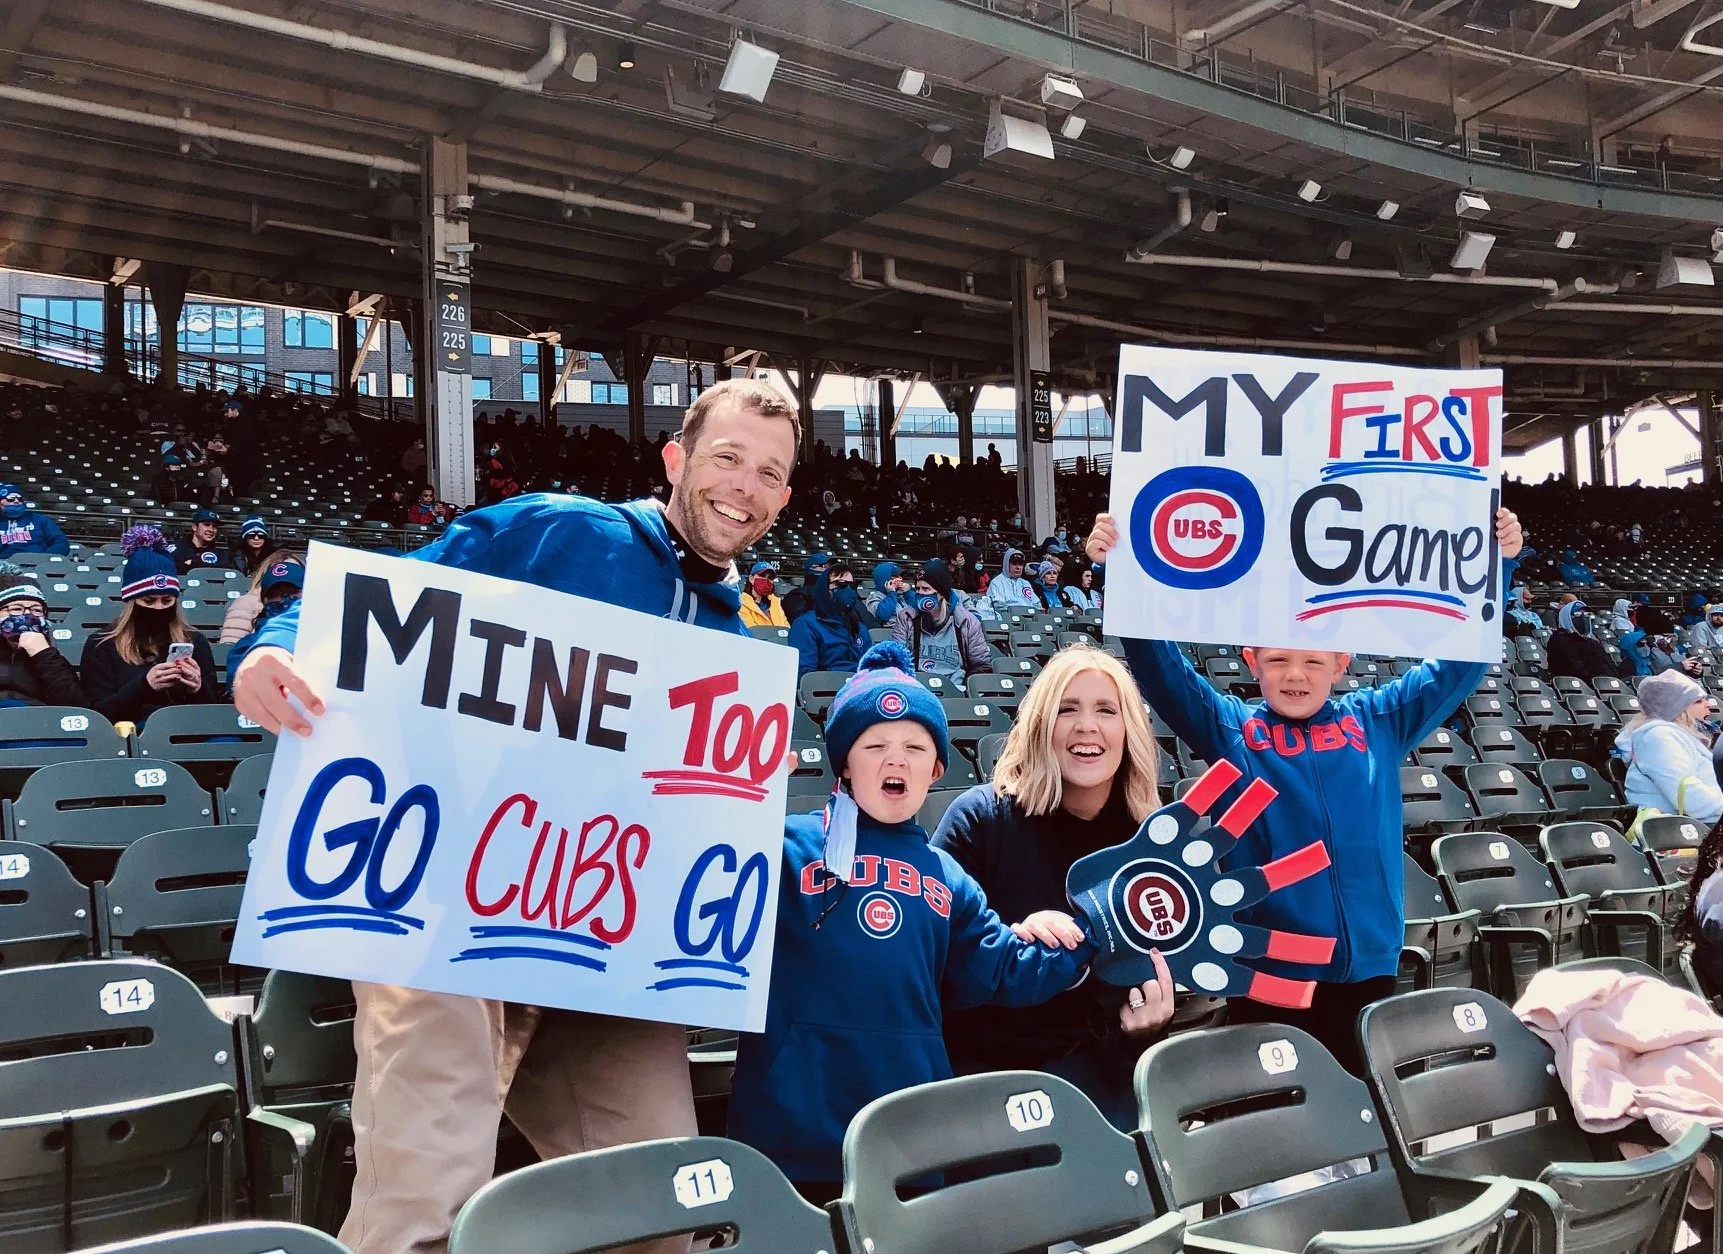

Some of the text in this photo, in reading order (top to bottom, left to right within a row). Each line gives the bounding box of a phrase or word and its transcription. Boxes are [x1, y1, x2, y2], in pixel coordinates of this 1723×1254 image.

[442, 304, 465, 322] 226
[442, 332, 466, 350] 225
[1034, 389, 1049, 403] 225
[1034, 410, 1050, 424] 223
[1121, 372, 1503, 467] MY FIRST
[1290, 483, 1500, 622] Game!
[271, 563, 289, 577] C
[57, 631, 68, 639] 12
[921, 645, 960, 667] UBS
[336, 572, 789, 788] MINE TOO
[66, 718, 83, 730] 13
[1243, 715, 1367, 757] CUBS
[808, 750, 816, 760] 9
[141, 771, 160, 784] 13
[1426, 776, 1433, 786] 5
[1575, 768, 1582, 777] 3
[1597, 834, 1604, 845] 6
[1686, 827, 1693, 837] 5
[1494, 845, 1502, 855] 7
[0, 858, 20, 875] 14
[286, 757, 769, 963] GO CUBS GO
[800, 854, 953, 918] CUBS
[865, 899, 896, 931] CUBS
[113, 985, 142, 1007] 14
[1463, 1008, 1476, 1027] 8
[1271, 1047, 1284, 1067] 9
[1016, 1098, 1043, 1123] 10
[688, 1168, 717, 1198] 11
